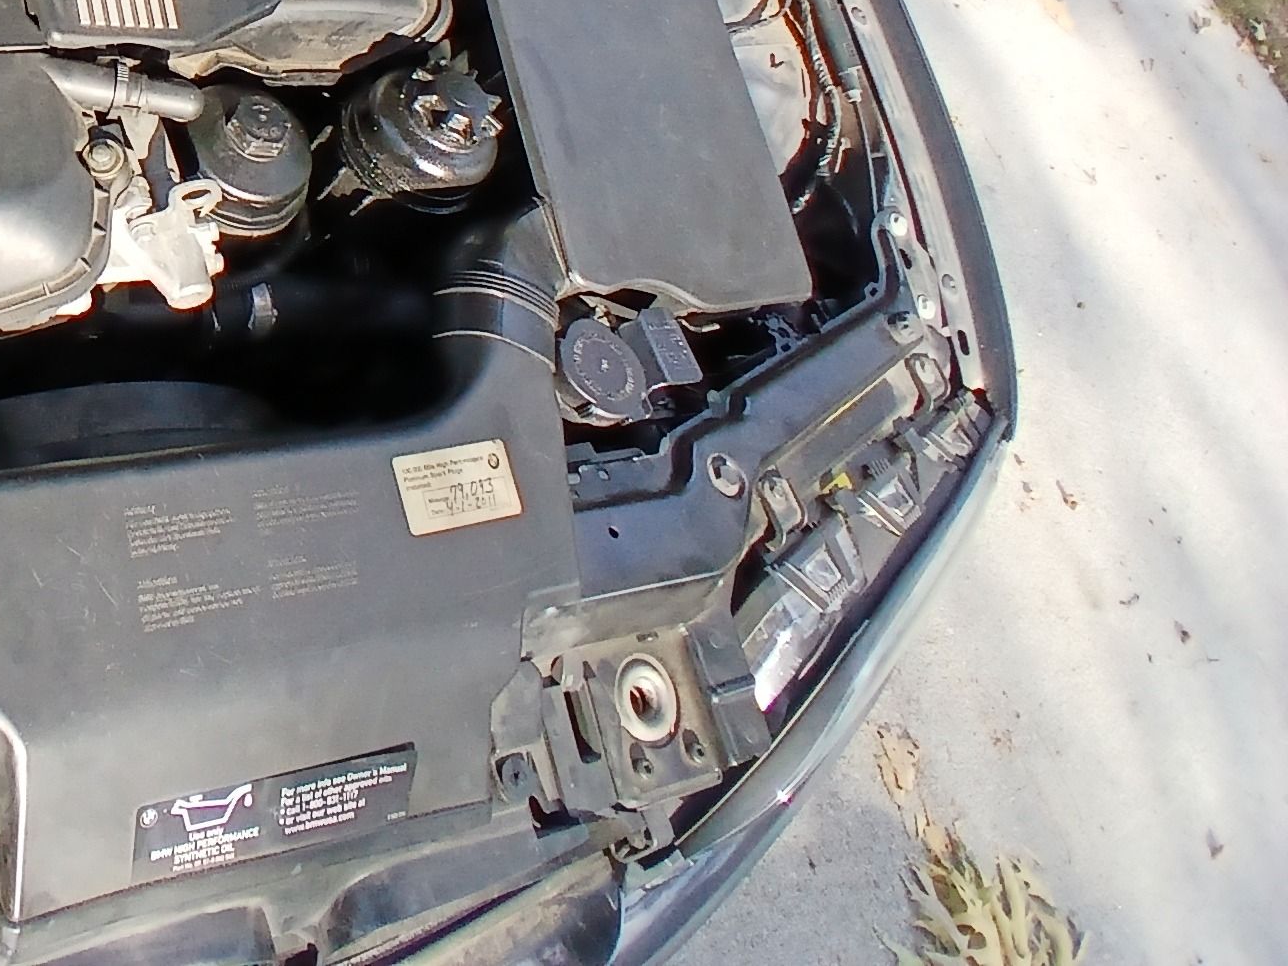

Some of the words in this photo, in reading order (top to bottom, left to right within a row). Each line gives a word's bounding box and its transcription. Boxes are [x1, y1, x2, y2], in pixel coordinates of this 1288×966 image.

[281, 787, 295, 798] For
[296, 782, 316, 794] more
[317, 778, 331, 788] info
[332, 775, 346, 785] see
[379, 762, 407, 775] Manual
[281, 797, 294, 807] For
[314, 788, 323, 799] of
[323, 785, 343, 796] other
[286, 804, 300, 815] call
[295, 811, 311, 822] visit
[312, 809, 325, 819] our
[326, 804, 342, 815] web
[151, 847, 173, 862] BMW
[173, 841, 195, 855] HIGH
[196, 826, 260, 850] PERFORMANCE
[189, 831, 205, 841] Use
[206, 825, 224, 838] only
[174, 845, 220, 865] SYNTHETIC
[220, 842, 235, 854] OIL
